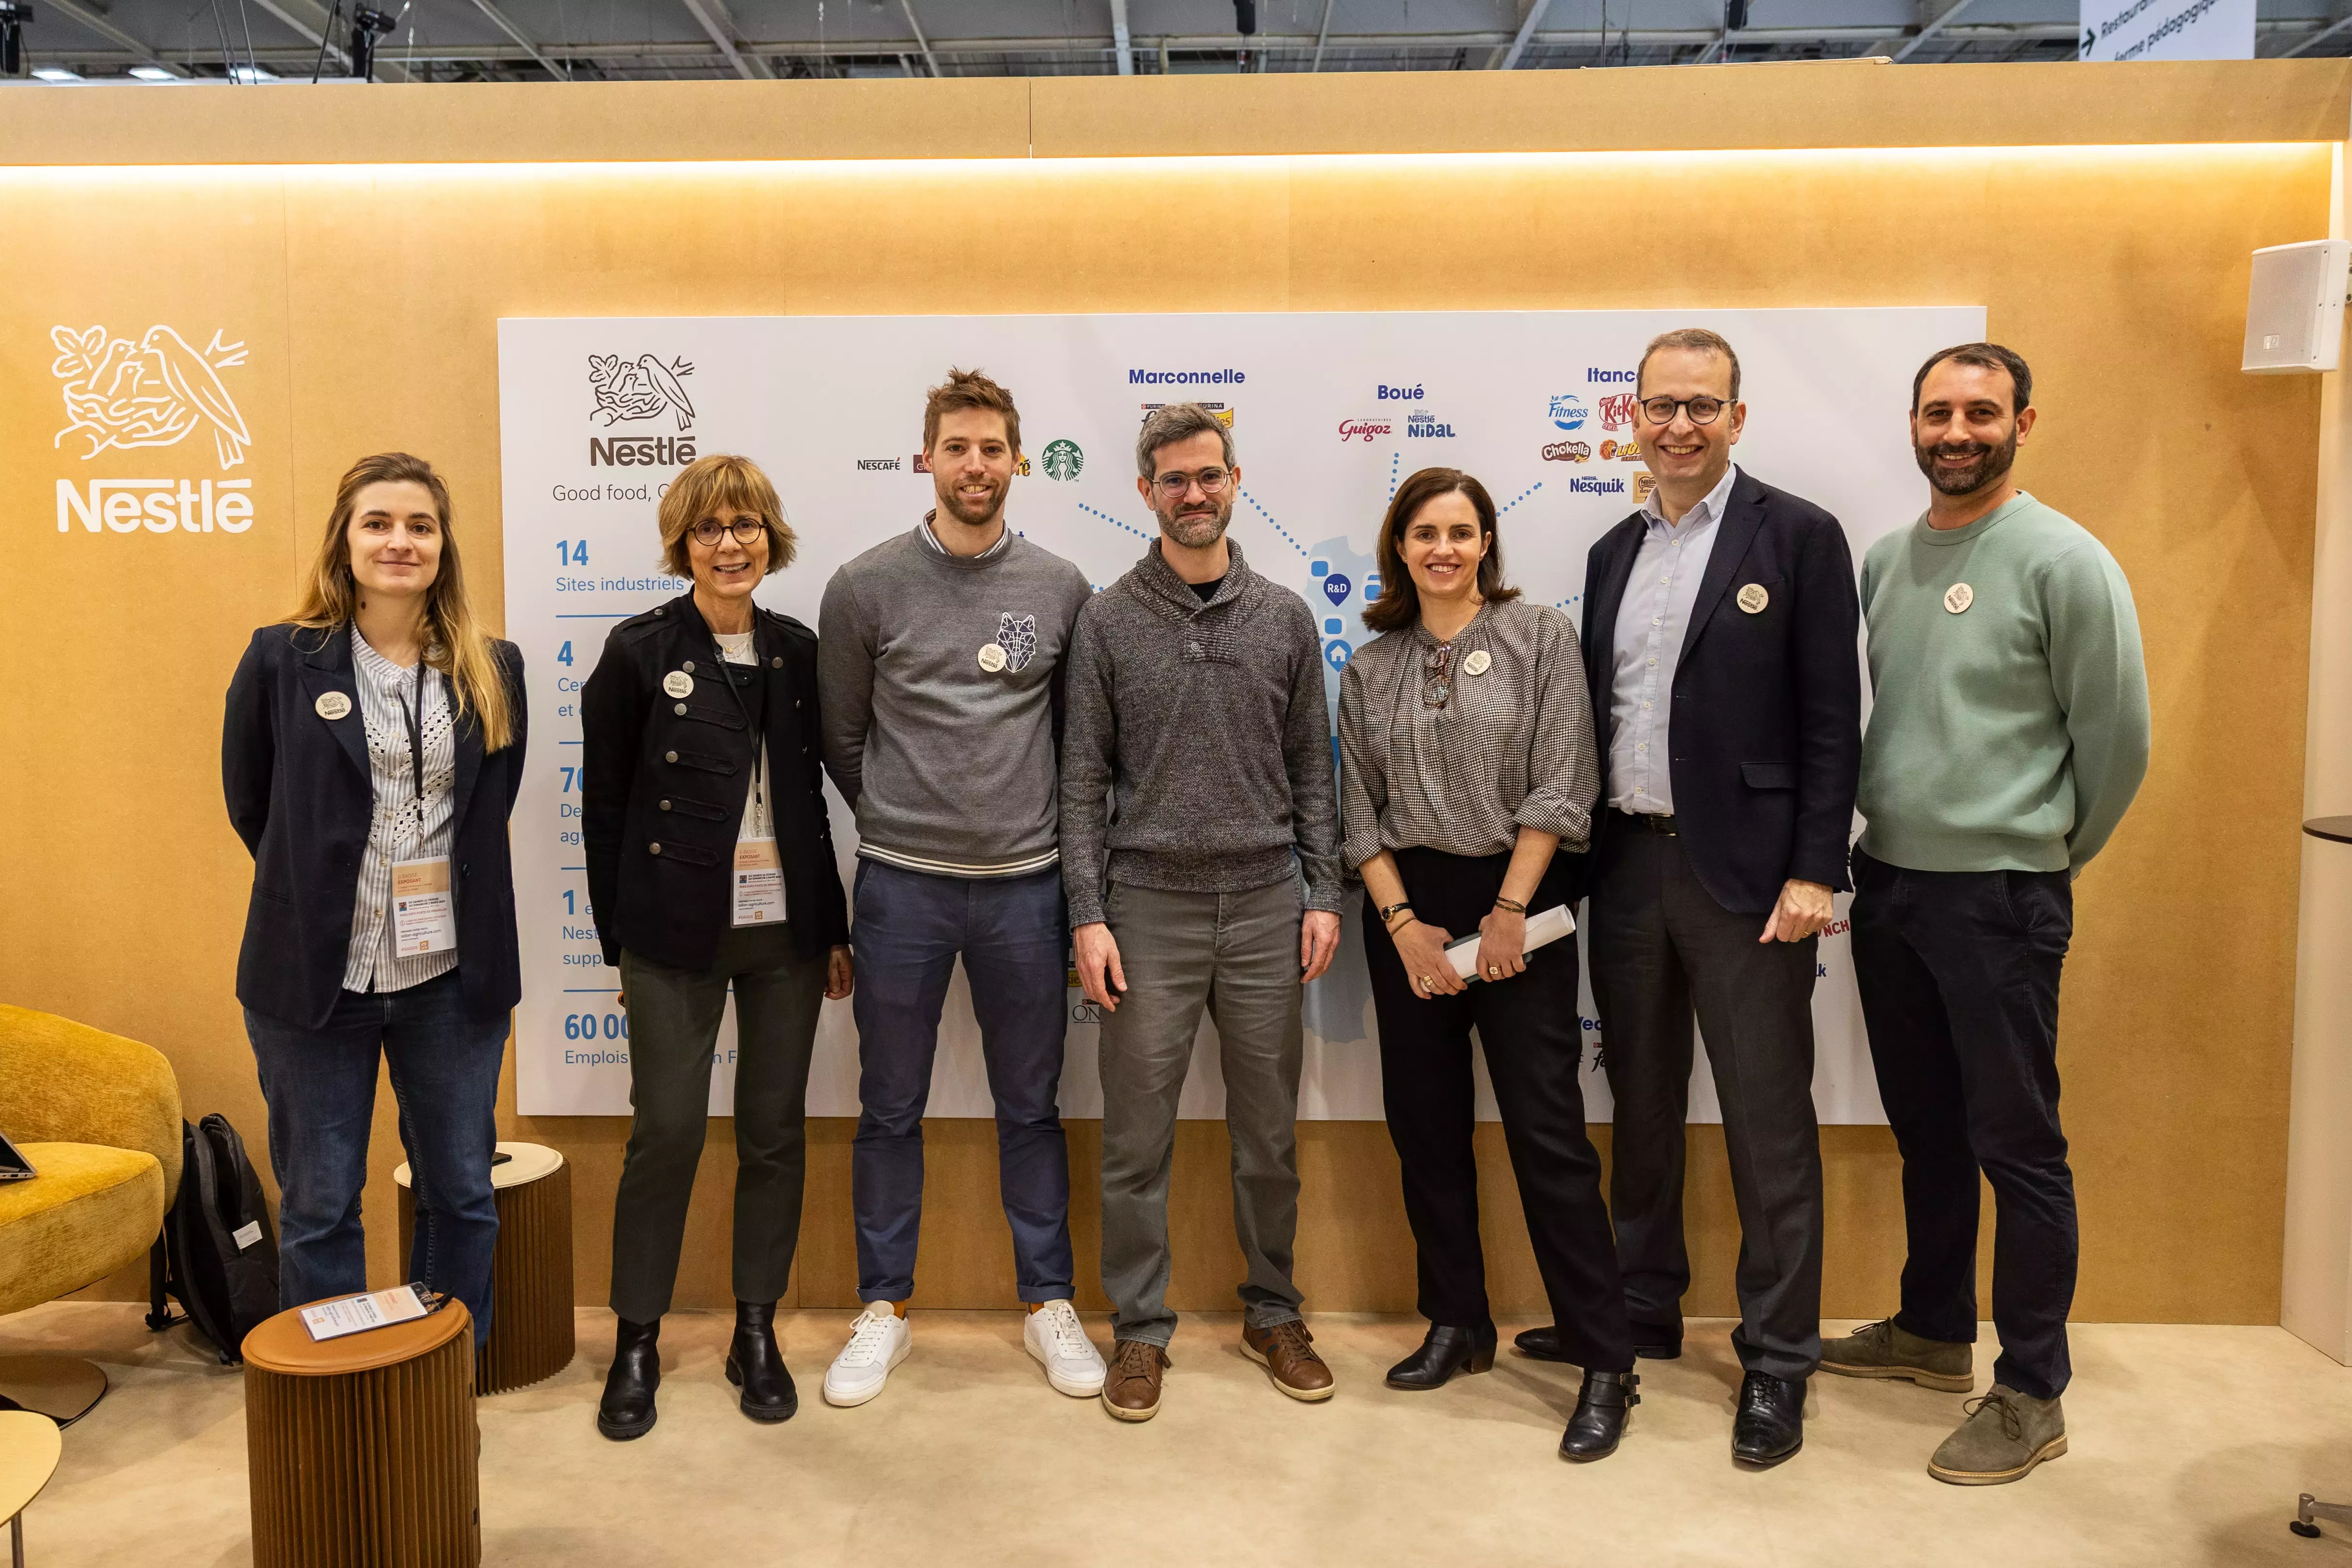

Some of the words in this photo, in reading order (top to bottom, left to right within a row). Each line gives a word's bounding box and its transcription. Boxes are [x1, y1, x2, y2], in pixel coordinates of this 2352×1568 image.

[1129, 369, 1245, 384] Marconnelle
[1588, 368, 1638, 382] Itanc
[1378, 383, 1424, 400] Boué
[1549, 402, 1588, 418] Fitness
[1408, 415, 1435, 423] Nestlé
[1339, 419, 1391, 442] Guigoz
[590, 436, 696, 466] Nestlé
[1544, 442, 1589, 459] Chokella
[858, 457, 900, 470] NESCAFÉ
[553, 484, 600, 501] Good
[607, 484, 651, 502] food,
[1570, 478, 1625, 496] Nesquik
[56, 479, 254, 533] Nestlé
[557, 540, 588, 566] 14
[556, 577, 595, 591] Sites
[601, 577, 684, 590] industriels
[1327, 583, 1347, 593] R&D
[1740, 598, 1758, 610] Nestlé
[558, 641, 573, 666] 4
[324, 708, 346, 716] Nestlé
[558, 704, 573, 716] et
[563, 890, 574, 915] 1
[565, 1014, 597, 1040] 60
[565, 1050, 628, 1067] Emplois
